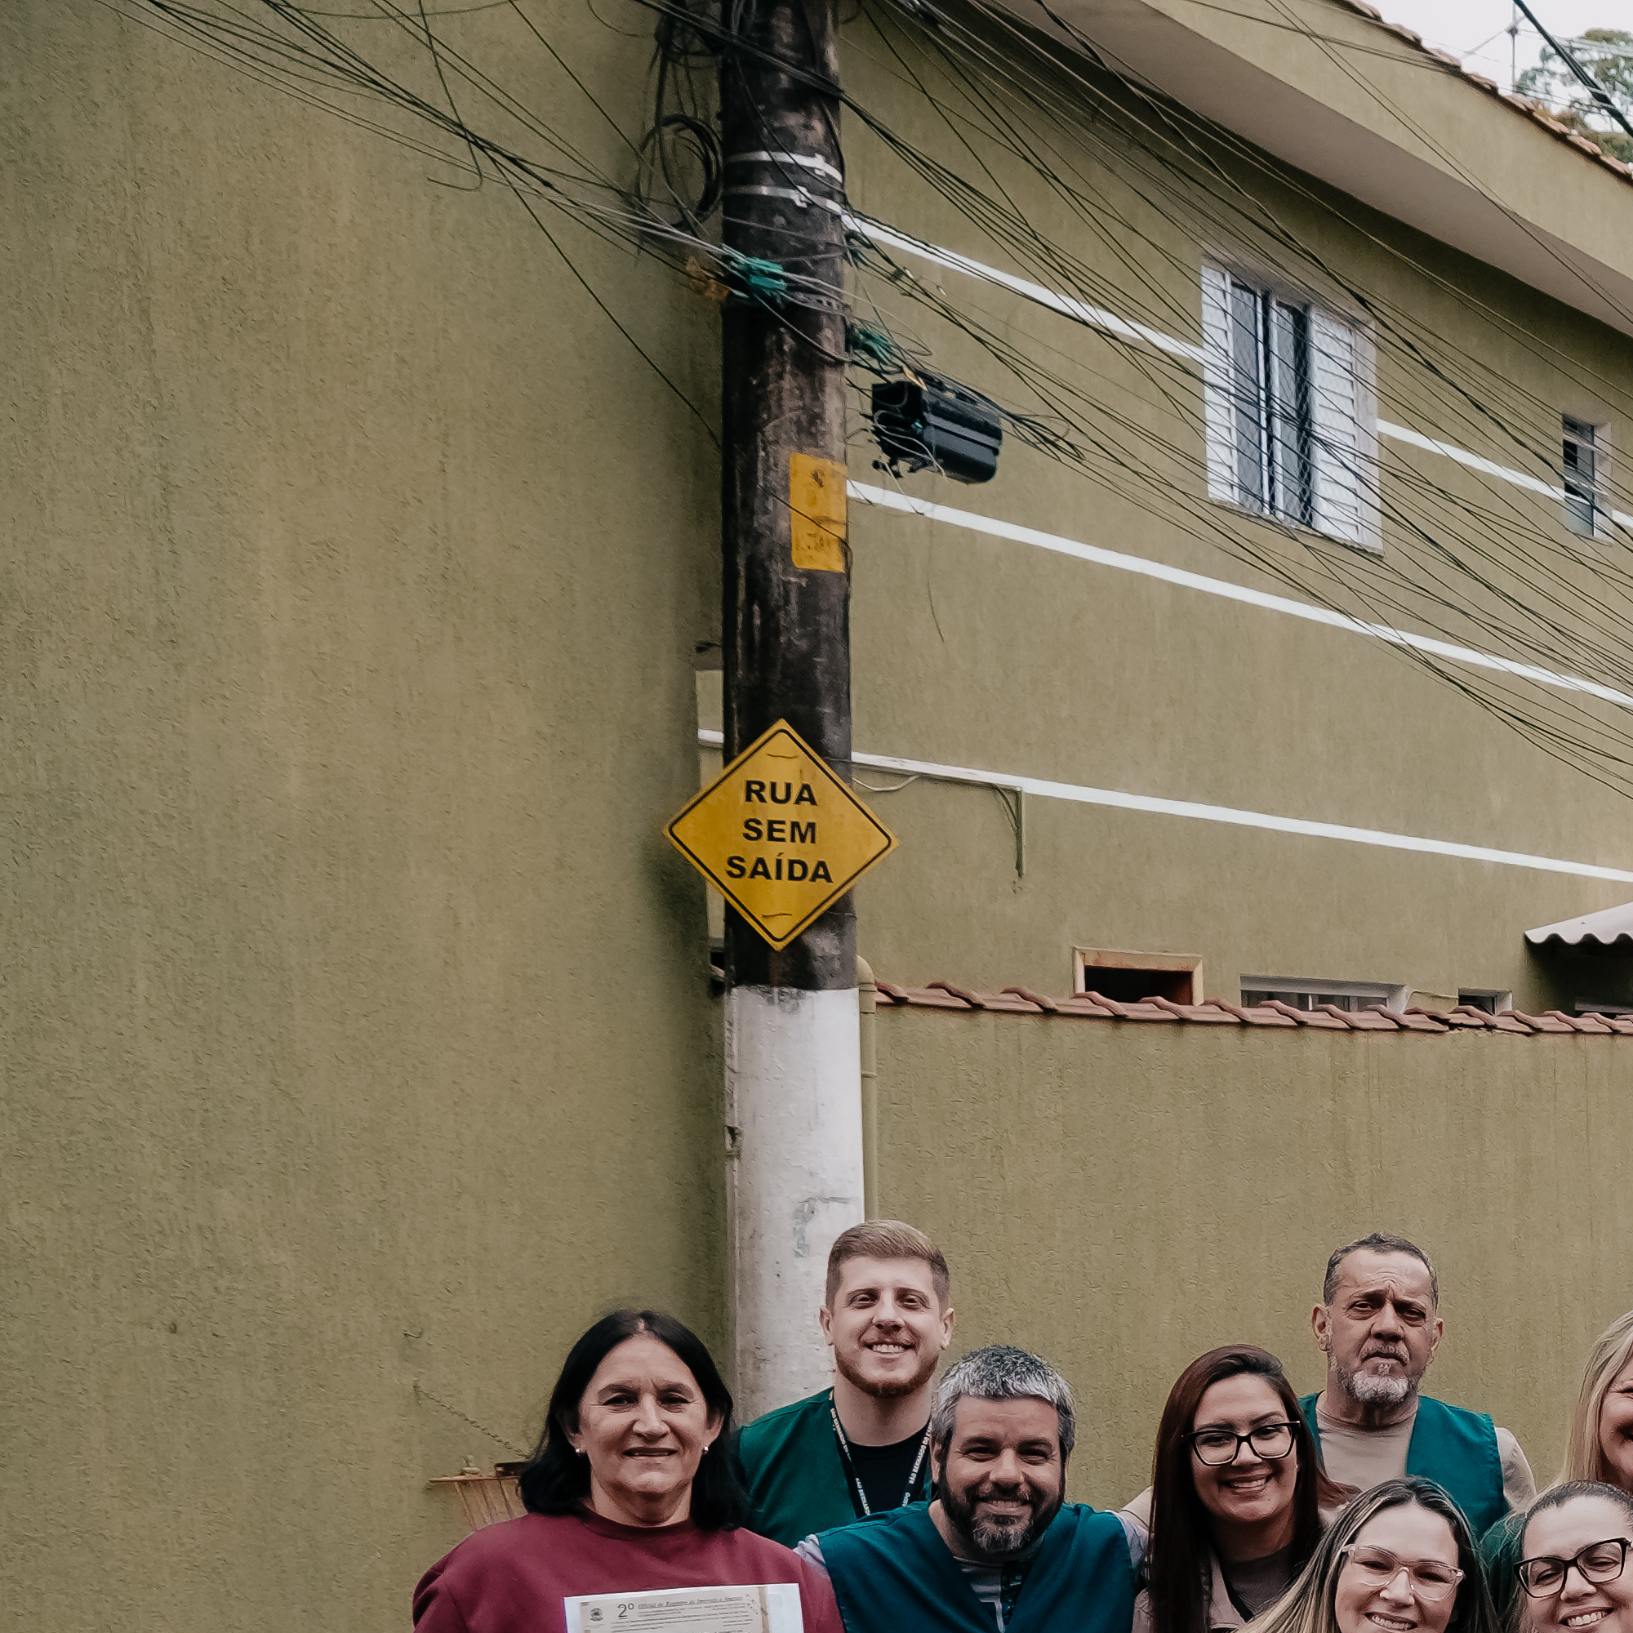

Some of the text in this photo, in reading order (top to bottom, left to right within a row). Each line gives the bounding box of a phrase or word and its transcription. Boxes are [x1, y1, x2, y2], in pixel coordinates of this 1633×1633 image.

[744, 780, 818, 806] RUA
[742, 818, 816, 844] SEM
[726, 852, 833, 883] SAÍDA
